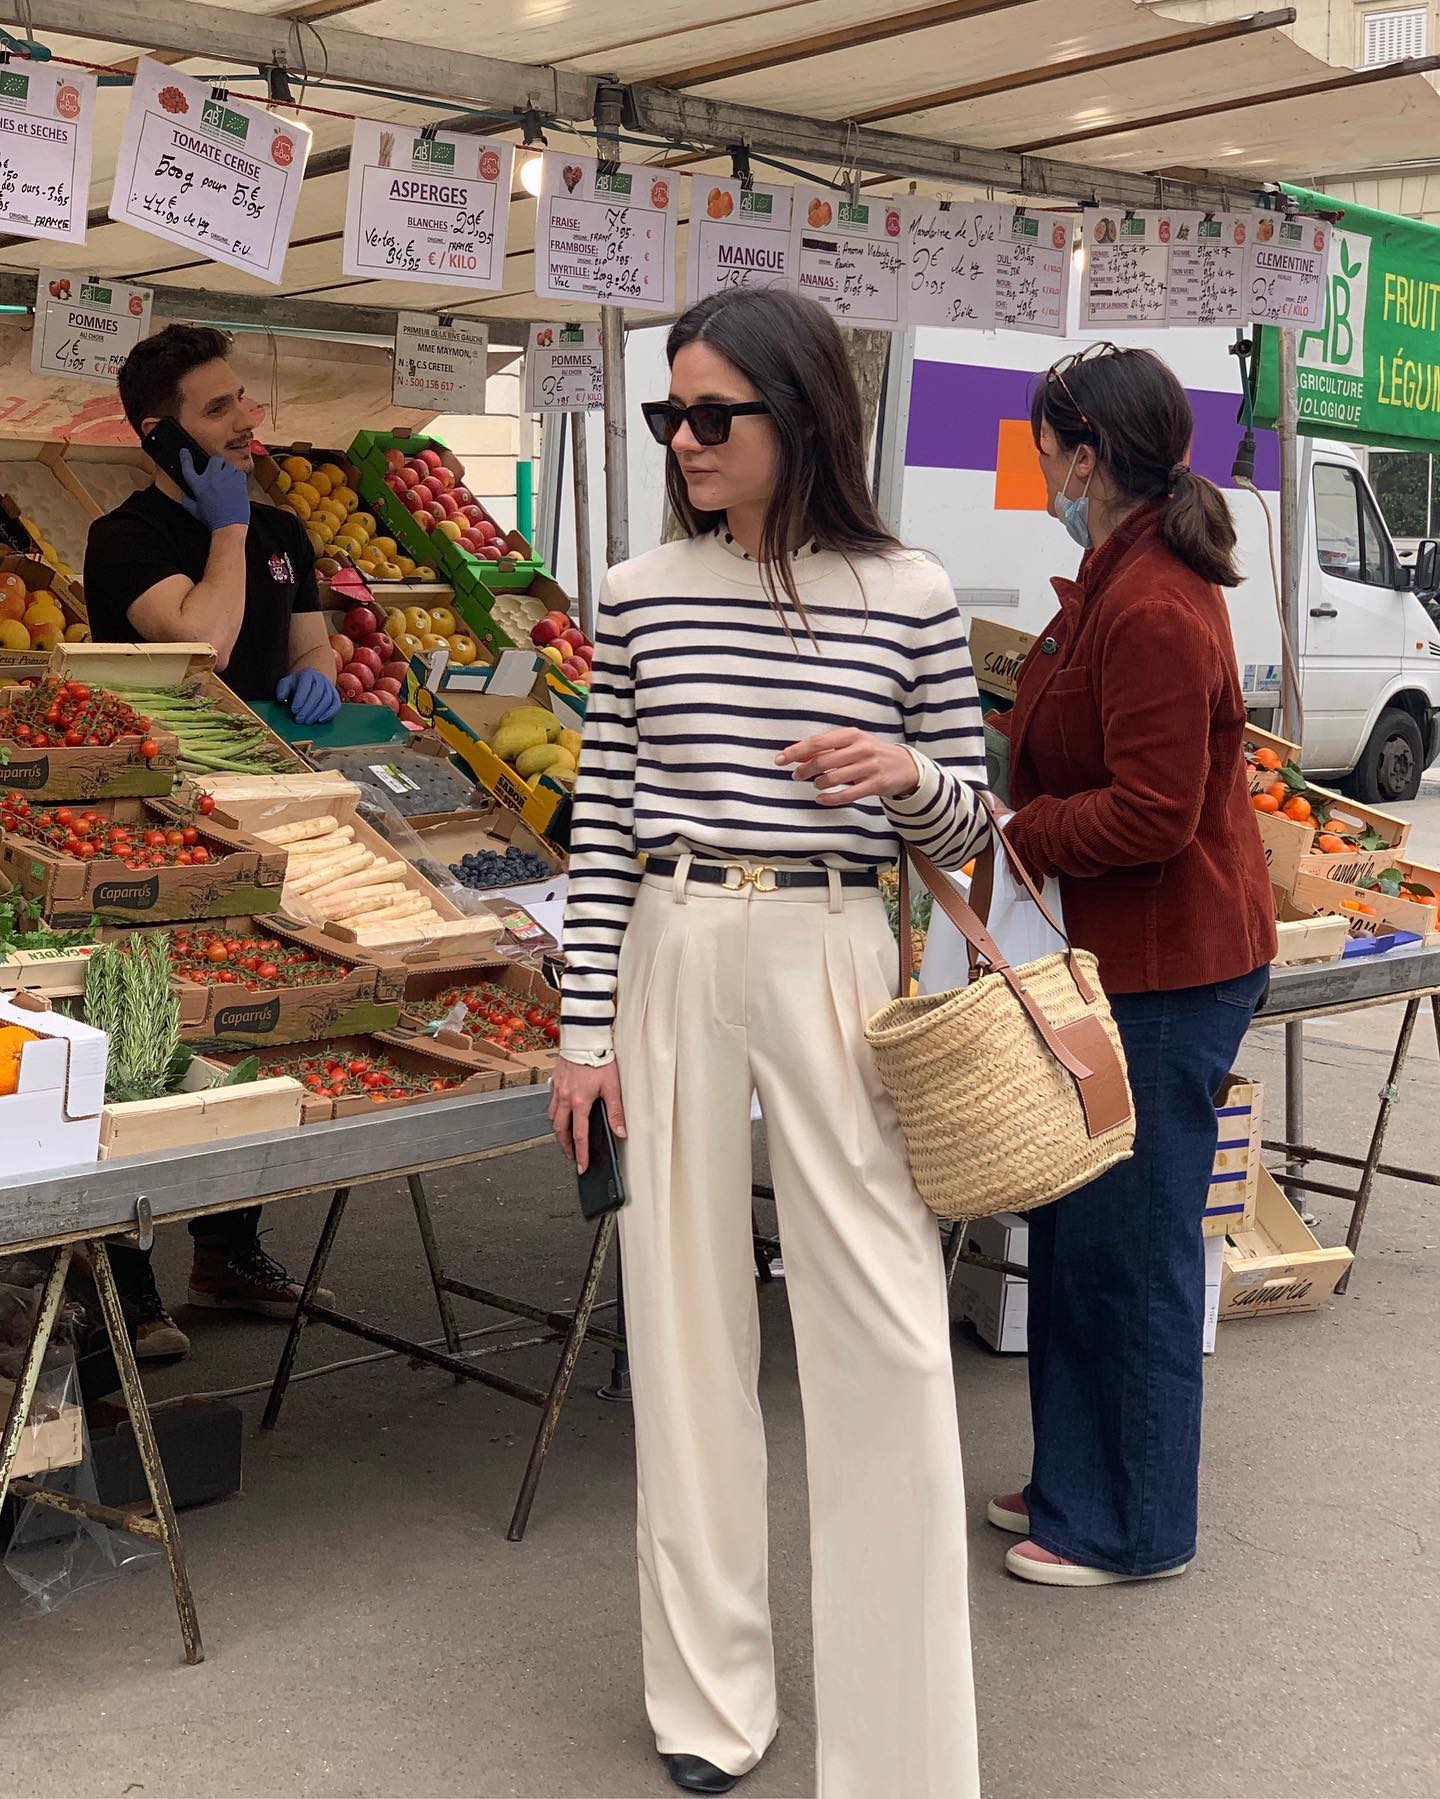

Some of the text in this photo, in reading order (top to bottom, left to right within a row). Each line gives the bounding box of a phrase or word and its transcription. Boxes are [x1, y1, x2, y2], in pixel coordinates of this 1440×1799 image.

[17, 122, 28, 134] et
[30, 124, 68, 142] SECHES
[171, 129, 222, 162] TOMATE
[223, 152, 262, 180] CERISE
[201, 176, 227, 193] pour
[389, 179, 468, 206] ASPERGES
[34, 215, 70, 229] FRANCE
[407, 216, 448, 230] BLANCHES
[551, 215, 581, 230] FRAISE:
[954, 219, 968, 239] de
[448, 241, 475, 253] FRANCE
[550, 240, 599, 256] FRAMBOISE:
[428, 252, 437, 266] €
[449, 254, 477, 270] KILO
[718, 244, 785, 270] MANGUE
[1256, 251, 1315, 273] CLEMENTINE
[550, 263, 590, 278] MYRTILLE:
[1293, 305, 1309, 317] KILO
[68, 312, 118, 333] POMMES
[403, 325, 430, 336] PRIMEUR
[461, 333, 483, 345] GAUCHE
[417, 343, 435, 353] MME
[428, 362, 454, 373] CRETEIL
[551, 355, 593, 366] POMMES
[410, 377, 424, 388] 500
[425, 380, 439, 389] 156
[440, 381, 454, 391] 617
[1296, 373, 1363, 399] GRICULTURE
[587, 393, 603, 401] KILO
[497, 776, 527, 809] SABOR
[100, 883, 151, 903] Caparrós
[28, 947, 80, 961] GARDEN
[221, 1006, 272, 1027] Caparrós
